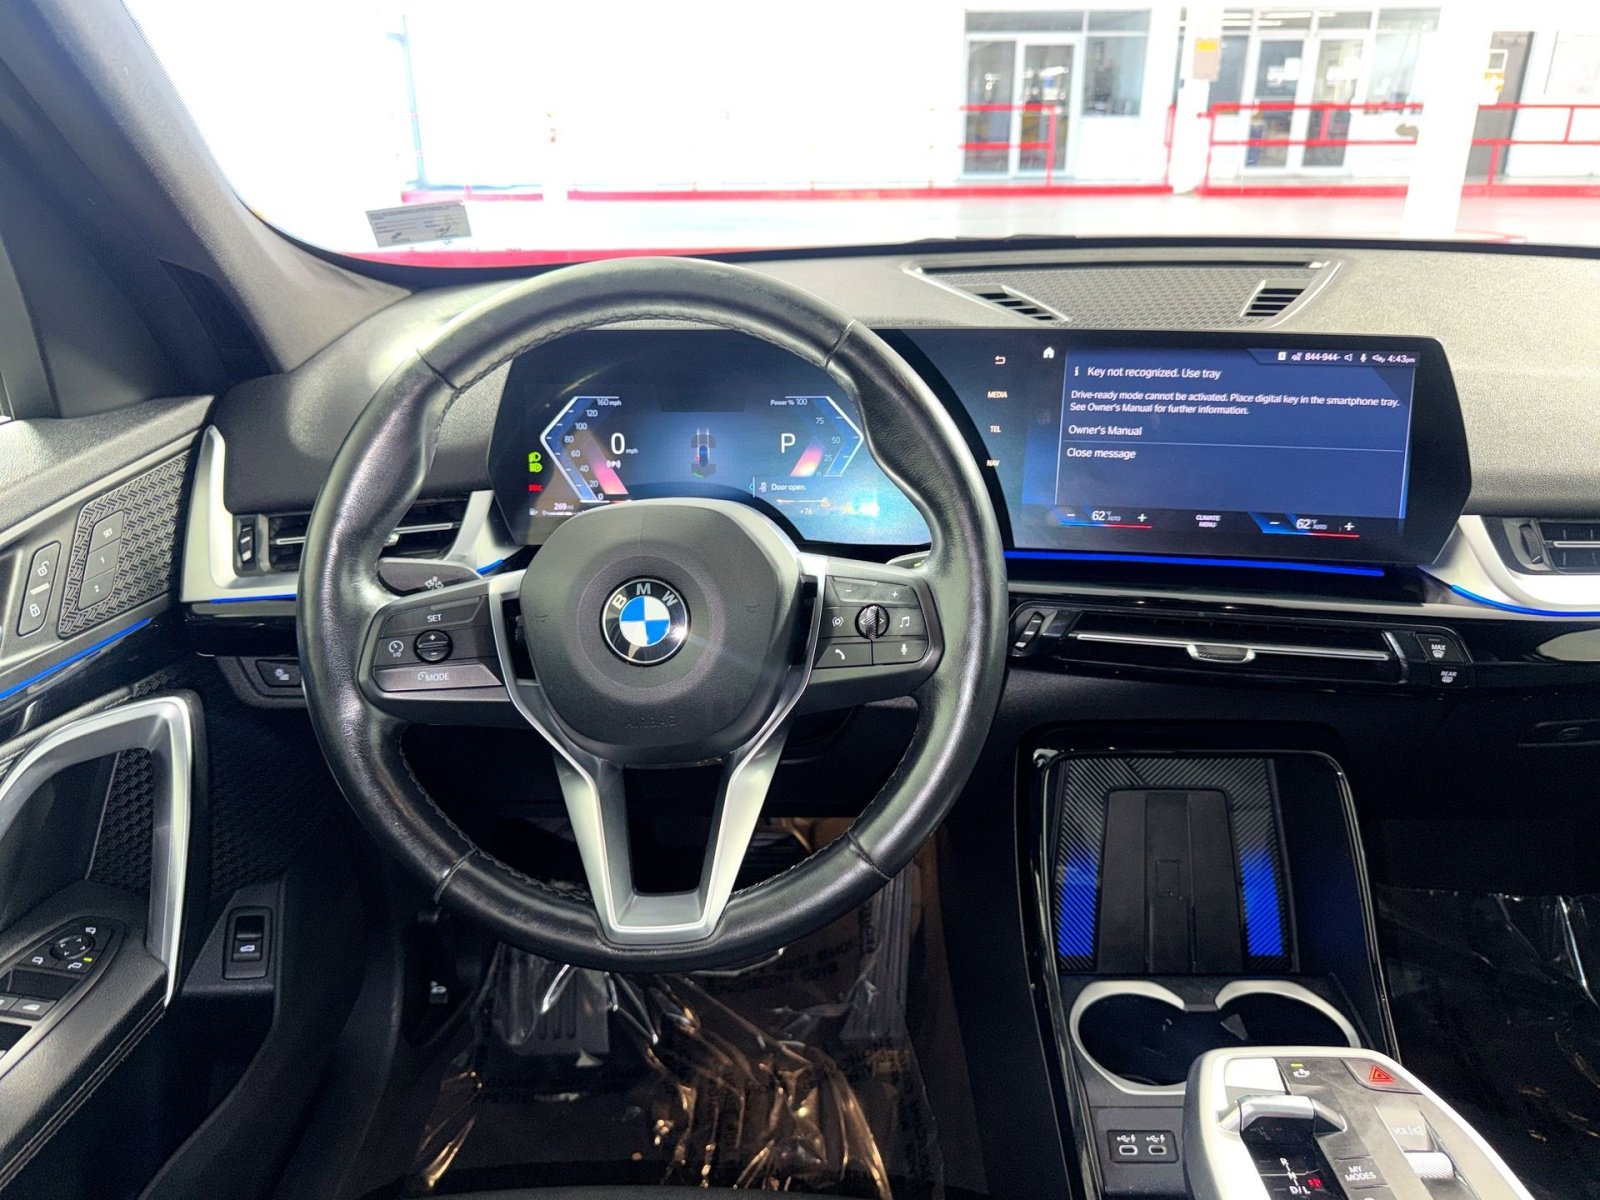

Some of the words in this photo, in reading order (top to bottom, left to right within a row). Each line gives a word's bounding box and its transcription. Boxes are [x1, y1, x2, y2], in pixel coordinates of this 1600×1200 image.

[1087, 366, 1106, 378] Key
[1107, 367, 1123, 377] not
[1125, 367, 1179, 380] recognized.
[1181, 368, 1200, 378] Use
[1202, 369, 1221, 381] tray
[986, 390, 1008, 398] MEDIA
[1070, 389, 1117, 401] Drive-ready
[1119, 390, 1143, 401] mode
[1144, 391, 1174, 402] cannot
[1175, 391, 1187, 402] be
[1188, 392, 1228, 403] activated.
[1229, 393, 1253, 404] Place
[1254, 394, 1281, 406] digital
[1283, 395, 1299, 406] key
[1300, 395, 1308, 404] in
[1310, 395, 1325, 405] the
[1326, 396, 1379, 408] smartphone
[1381, 397, 1400, 408] tray.
[796, 398, 808, 406] 100
[586, 409, 598, 417] 120
[1070, 402, 1086, 411] See
[1087, 402, 1121, 412] Owner's
[1122, 403, 1152, 413] Manual
[1154, 404, 1166, 413] for
[1167, 404, 1196, 414] further
[1198, 405, 1248, 415] information.
[815, 416, 825, 425] 75
[574, 422, 588, 430] 100
[989, 425, 1001, 433] TEL
[1068, 424, 1106, 436] Owner's
[1108, 425, 1142, 437] Manual
[564, 435, 574, 443] 80
[610, 432, 625, 455] 0
[781, 433, 796, 453] P
[831, 436, 841, 444] 50
[824, 454, 833, 462] 25
[1066, 447, 1093, 458] Close
[1094, 449, 1136, 461] message
[579, 464, 589, 473] 40
[589, 480, 598, 488] 20
[771, 483, 787, 491] Door
[788, 484, 806, 492] open.
[1195, 514, 1222, 522] CLIMATE
[611, 582, 678, 610] BMW
[427, 614, 442, 622] SET
[426, 672, 450, 681] MODE
[1348, 1165, 1362, 1173] MY
[1344, 1171, 1377, 1182] MODES
